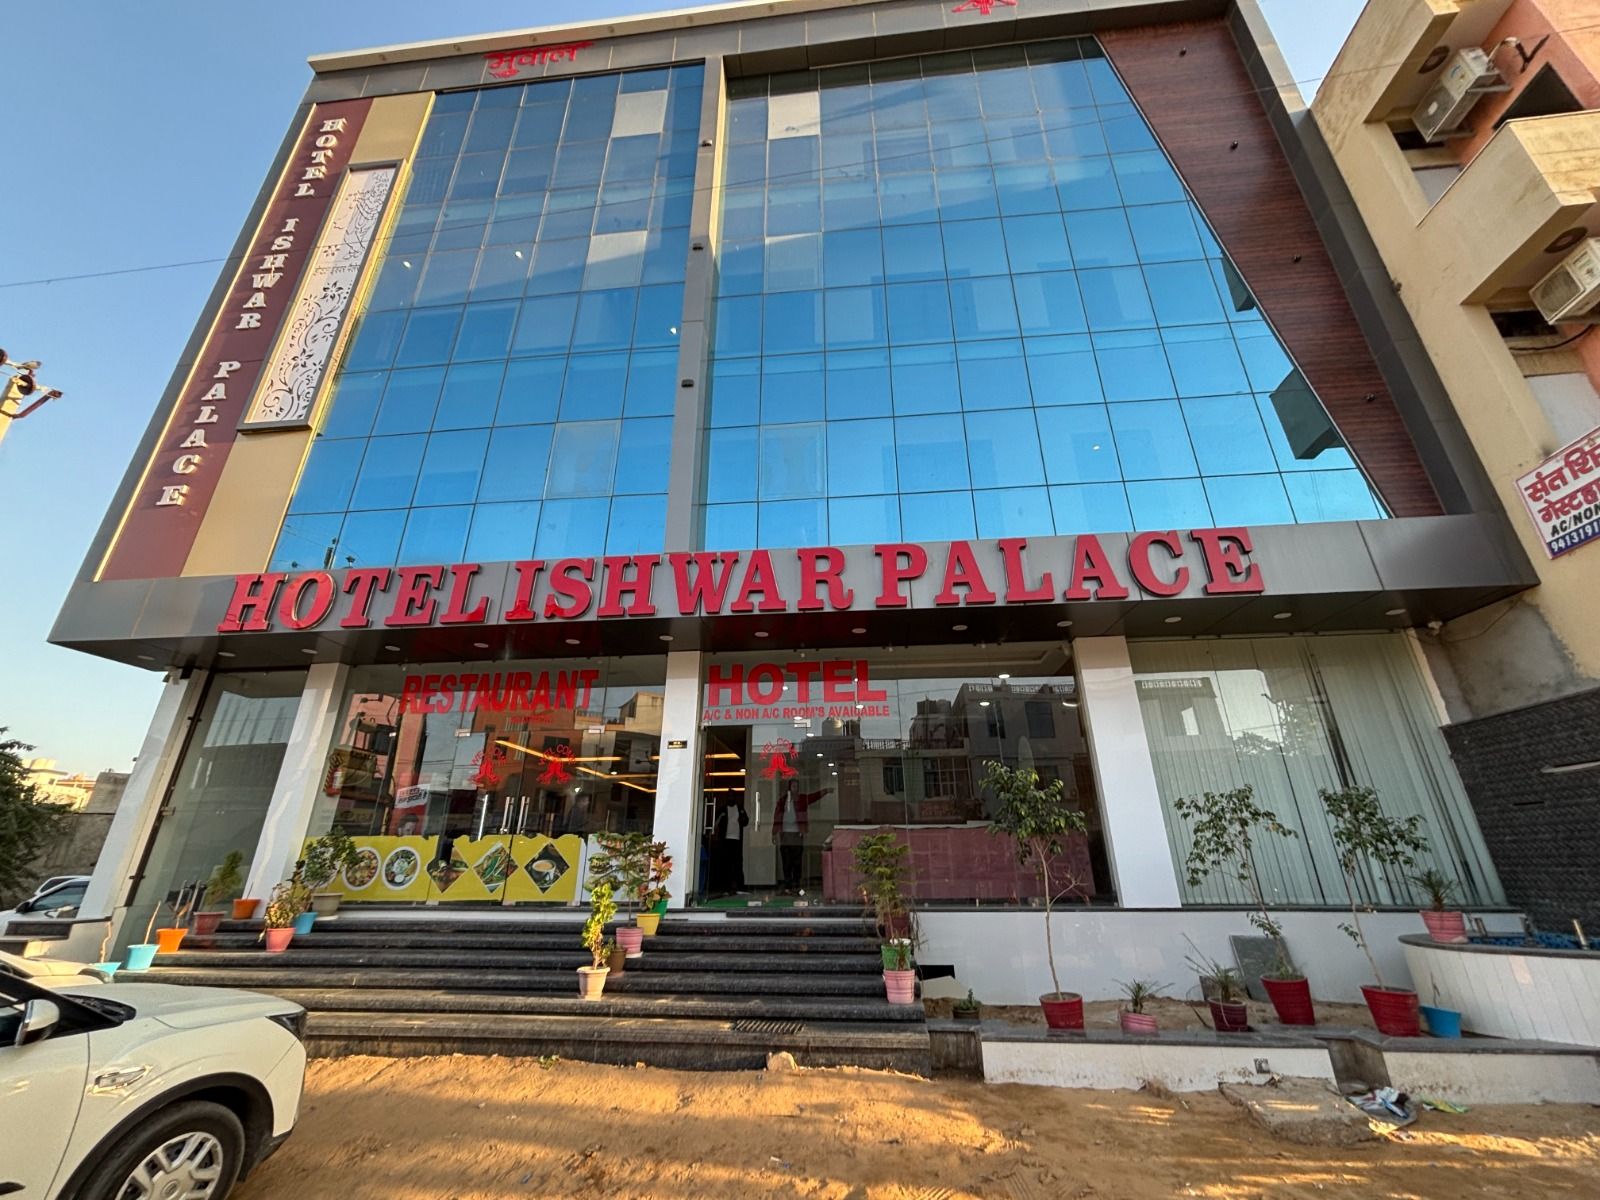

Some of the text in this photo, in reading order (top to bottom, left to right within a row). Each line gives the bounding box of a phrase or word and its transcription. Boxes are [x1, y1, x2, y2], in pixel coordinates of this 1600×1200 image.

[295, 117, 347, 197] HOTEL
[235, 217, 300, 329] ISHWAR
[155, 360, 241, 506] PALACE
[1524, 471, 1569, 502] संत
[218, 527, 1266, 633] HOTEL ISHWAR PALACE
[399, 669, 600, 714] RESTAURANT
[703, 708, 721, 721] A/C
[724, 708, 733, 720] &
[736, 707, 759, 720] NON
[762, 707, 780, 719] A/C
[783, 706, 825, 718] ROOM'S
[708, 660, 887, 707] HOTEL
